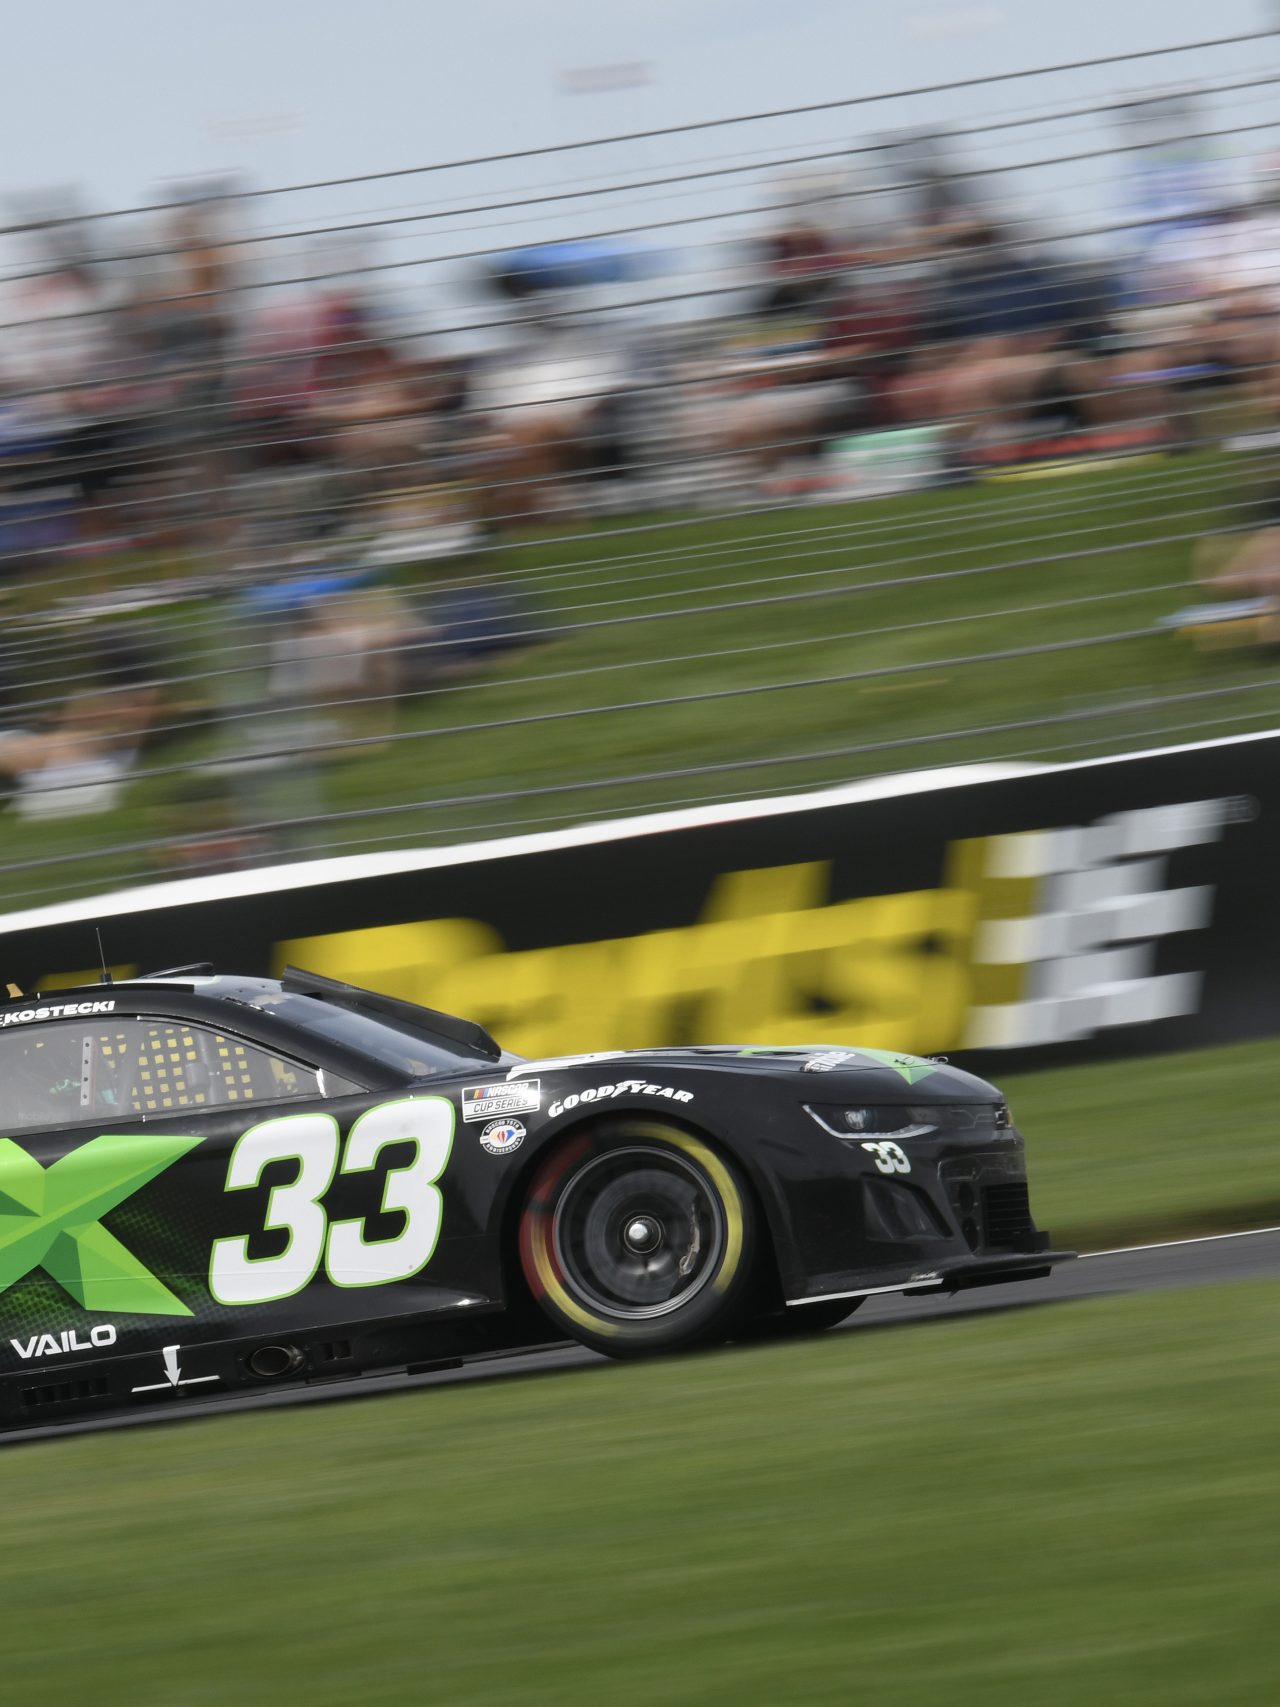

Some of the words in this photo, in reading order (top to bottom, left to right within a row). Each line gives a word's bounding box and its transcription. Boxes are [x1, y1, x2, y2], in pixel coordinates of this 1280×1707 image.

[3, 1000, 115, 1025] KOSTECKI
[473, 1102, 493, 1113] CUP
[495, 1098, 528, 1109] SERIES
[488, 1083, 529, 1097] NASCAR
[548, 1080, 695, 1118] GOODYEAR
[860, 1140, 912, 1175] 33
[209, 1095, 456, 1306] 33
[9, 1324, 117, 1359] VAILO
